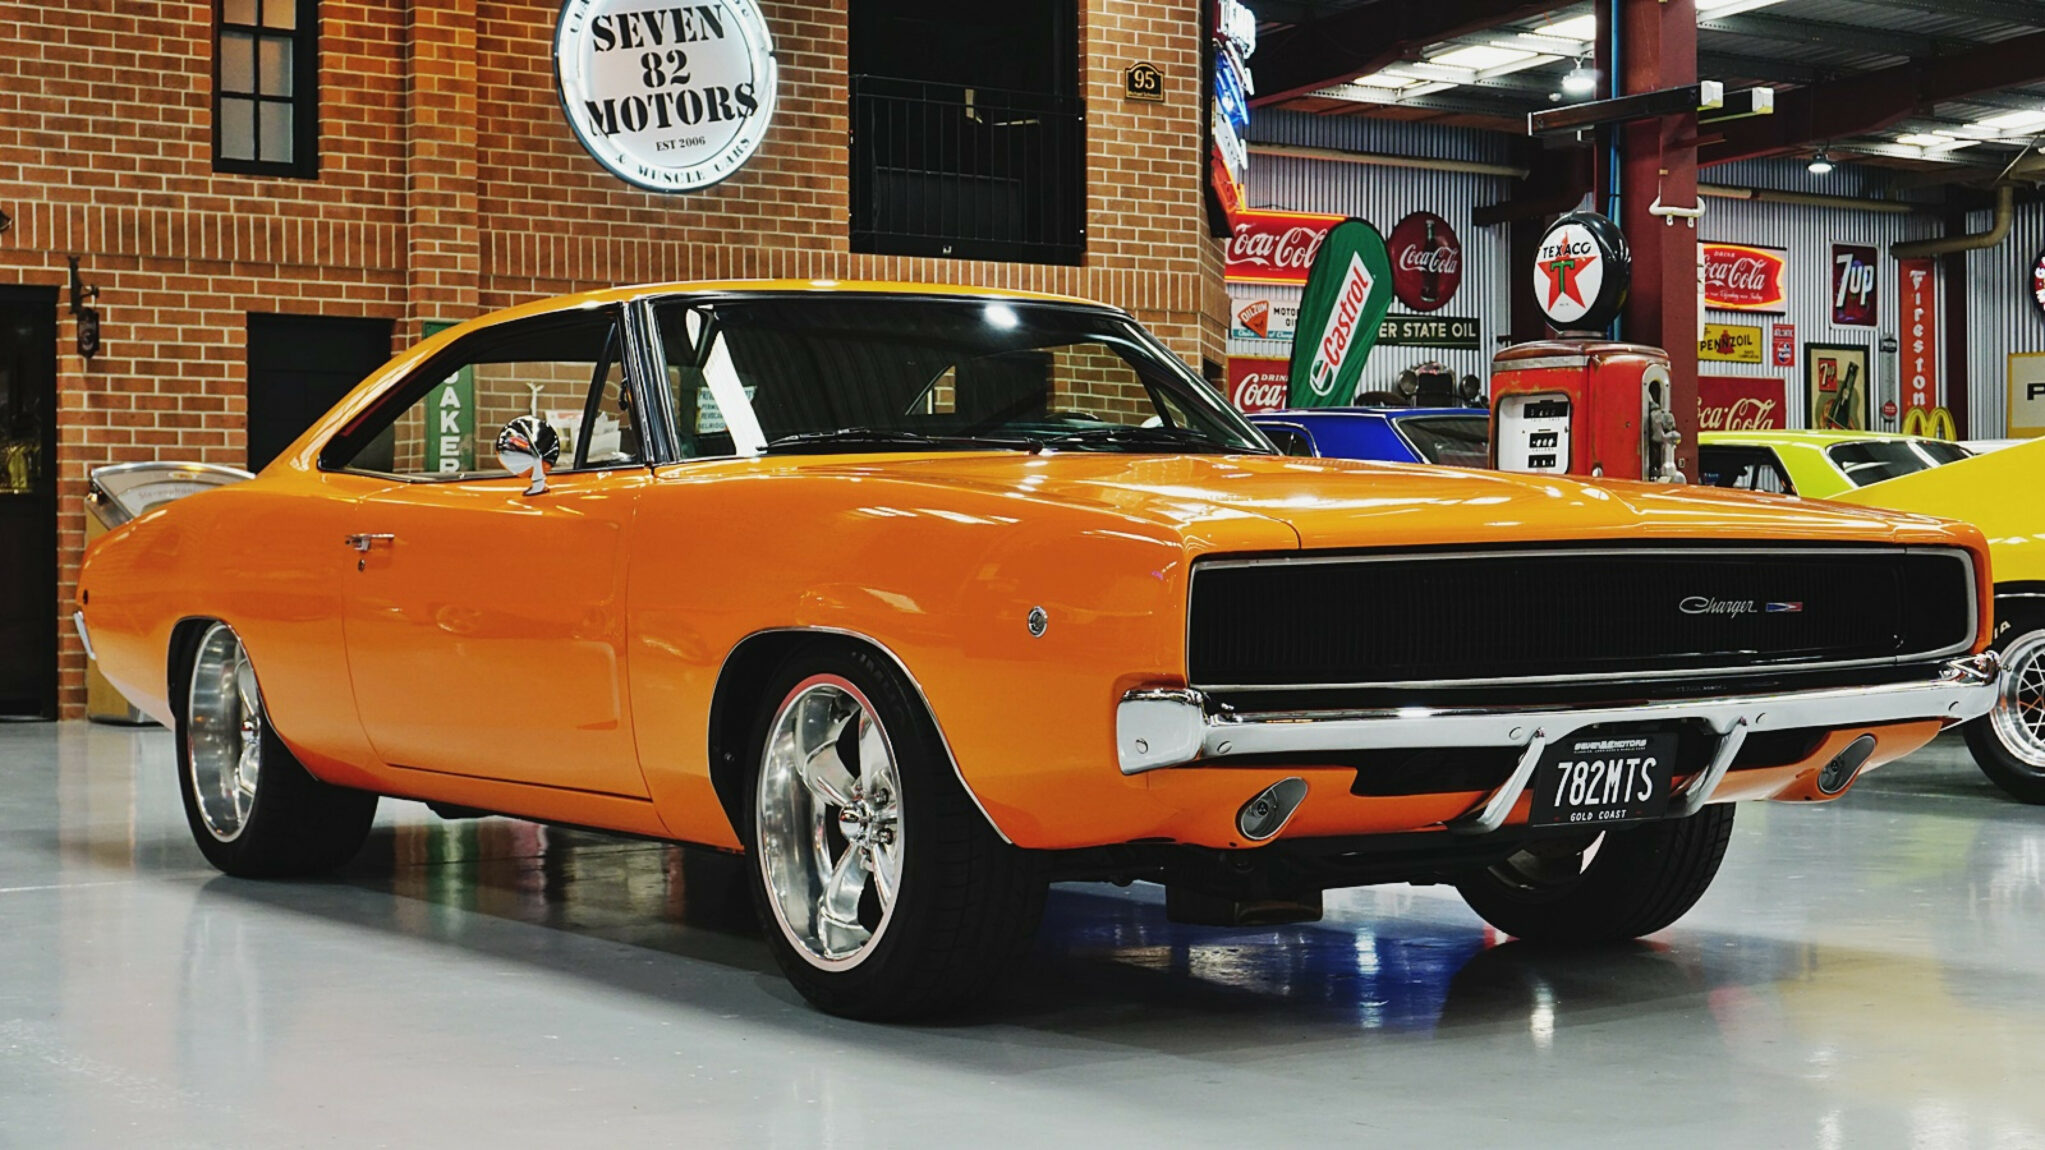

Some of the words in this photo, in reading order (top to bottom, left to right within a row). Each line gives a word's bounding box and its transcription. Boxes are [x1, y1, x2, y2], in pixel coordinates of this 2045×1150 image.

[591, 4, 725, 52] SEVEN
[640, 49, 691, 88] 82
[1134, 70, 1155, 89] 95
[585, 82, 758, 139] MOTORS
[656, 141, 676, 151] EST
[679, 136, 706, 148] 2006
[637, 164, 706, 184] MUSCLE
[714, 137, 750, 172] CARS
[1225, 223, 1328, 269] Coca-Col
[1399, 243, 1459, 274] Coca-Cola
[1543, 241, 1591, 259] TEXACO
[1550, 259, 1575, 294] T
[1704, 254, 1768, 290] oca-Cola
[1242, 303, 1268, 322] OILZUM
[1273, 307, 1298, 316] MOTO
[1323, 265, 1369, 367] Castrol
[1379, 322, 1398, 338] ER
[1403, 322, 1446, 338] STATE
[1452, 322, 1476, 337] OIL
[1700, 333, 1753, 352] PENNZOIL
[1909, 269, 1927, 406] Fireston
[1261, 374, 1288, 382] DRIN
[1679, 596, 1758, 619] Charger
[1554, 757, 1657, 807] 782MTS
[1570, 811, 1594, 822] GOLD
[1598, 809, 1627, 820] COAST
